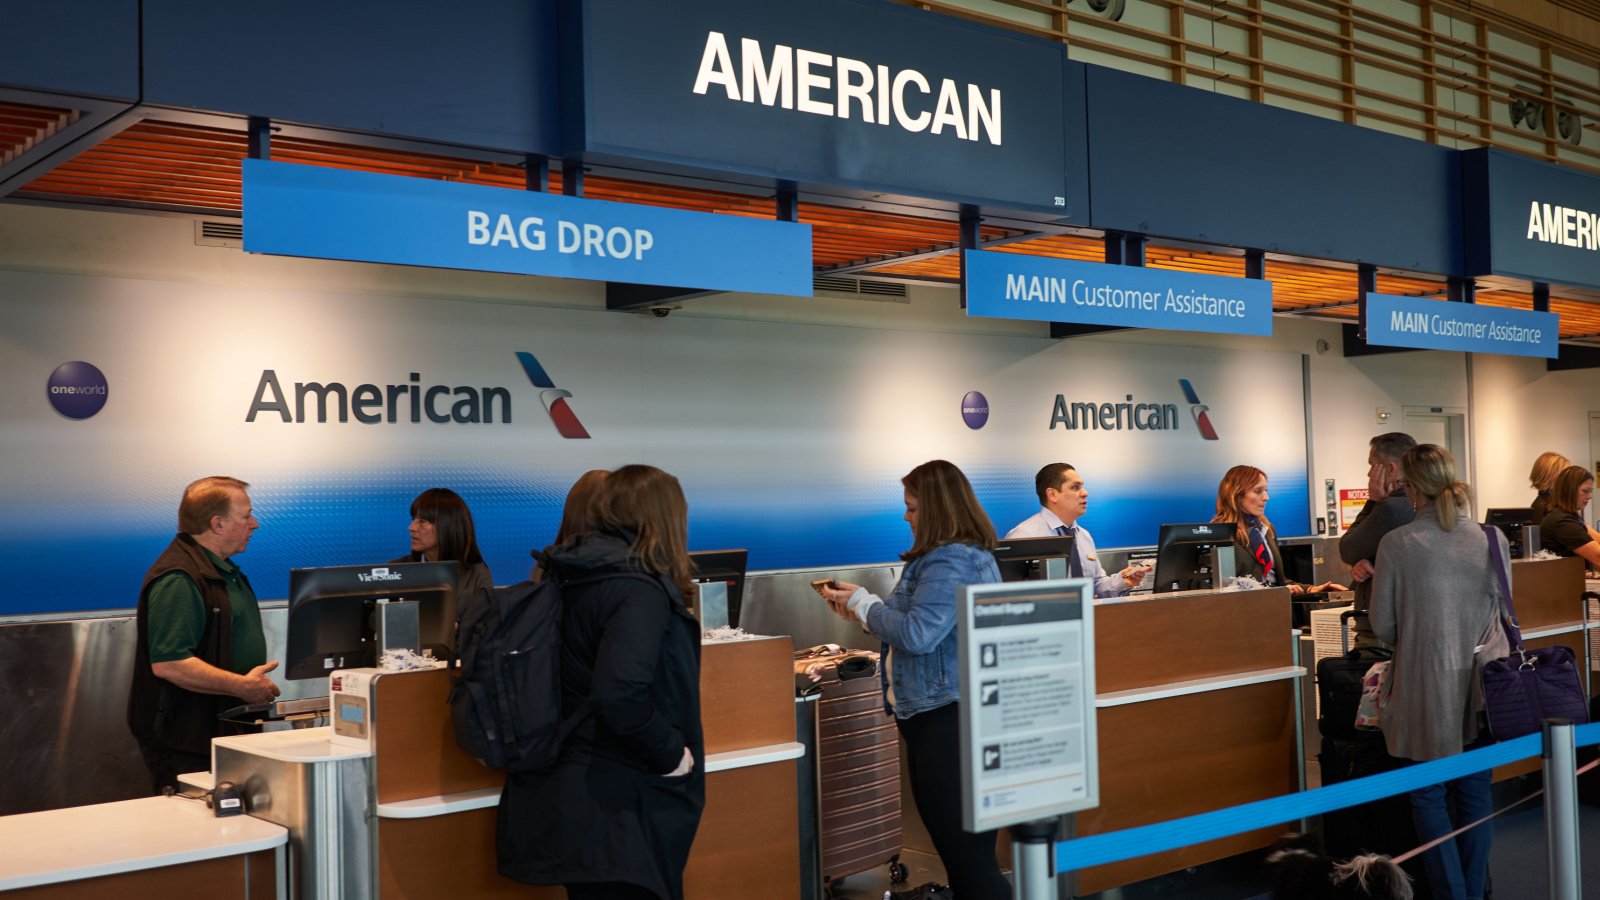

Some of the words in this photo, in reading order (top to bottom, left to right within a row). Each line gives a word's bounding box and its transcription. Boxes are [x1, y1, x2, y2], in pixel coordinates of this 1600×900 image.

[693, 31, 1002, 146] AMERICAN
[468, 211, 546, 251] BAG
[558, 222, 653, 260] DROP
[1006, 273, 1067, 304] MAIN
[1072, 279, 1161, 311] Customer
[1164, 288, 1246, 318] Assistance
[1390, 310, 1429, 335] MAIN
[1431, 314, 1487, 339] Customer
[1488, 321, 1541, 344] Assistance
[51, 384, 106, 395] oneworld
[245, 370, 512, 424] American
[1049, 394, 1179, 431] American
[1347, 490, 1370, 500] NOTICE
